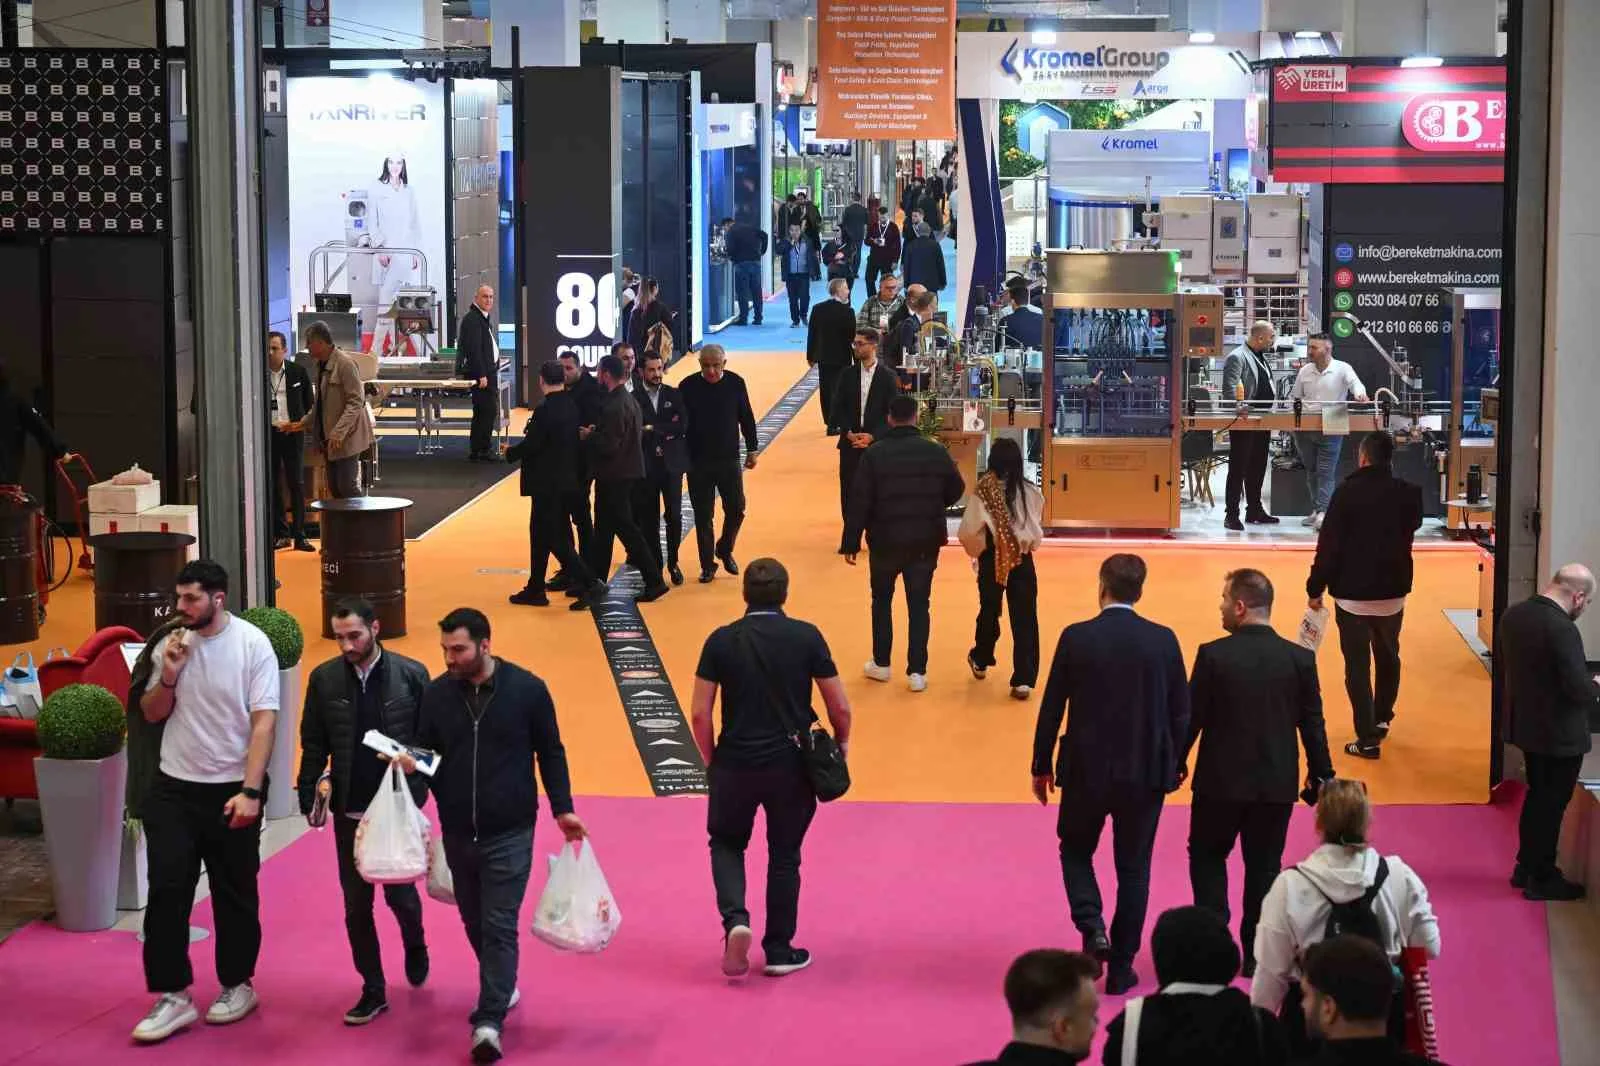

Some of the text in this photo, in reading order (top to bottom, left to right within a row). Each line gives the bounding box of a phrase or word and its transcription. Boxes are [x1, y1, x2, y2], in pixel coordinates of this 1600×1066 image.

[1304, 68, 1336, 78] YERLİ
[1303, 80, 1344, 90] ÜRETİM
[1112, 138, 1158, 150] Kromel
[1358, 246, 1502, 261] info@bereketmakina.com
[1358, 272, 1500, 284] www.bereketmakina.com
[1358, 294, 1439, 306] 0530 084 07 66
[1386, 320, 1406, 334] 610
[1408, 320, 1422, 334] 66
[1424, 320, 1438, 334] 66
